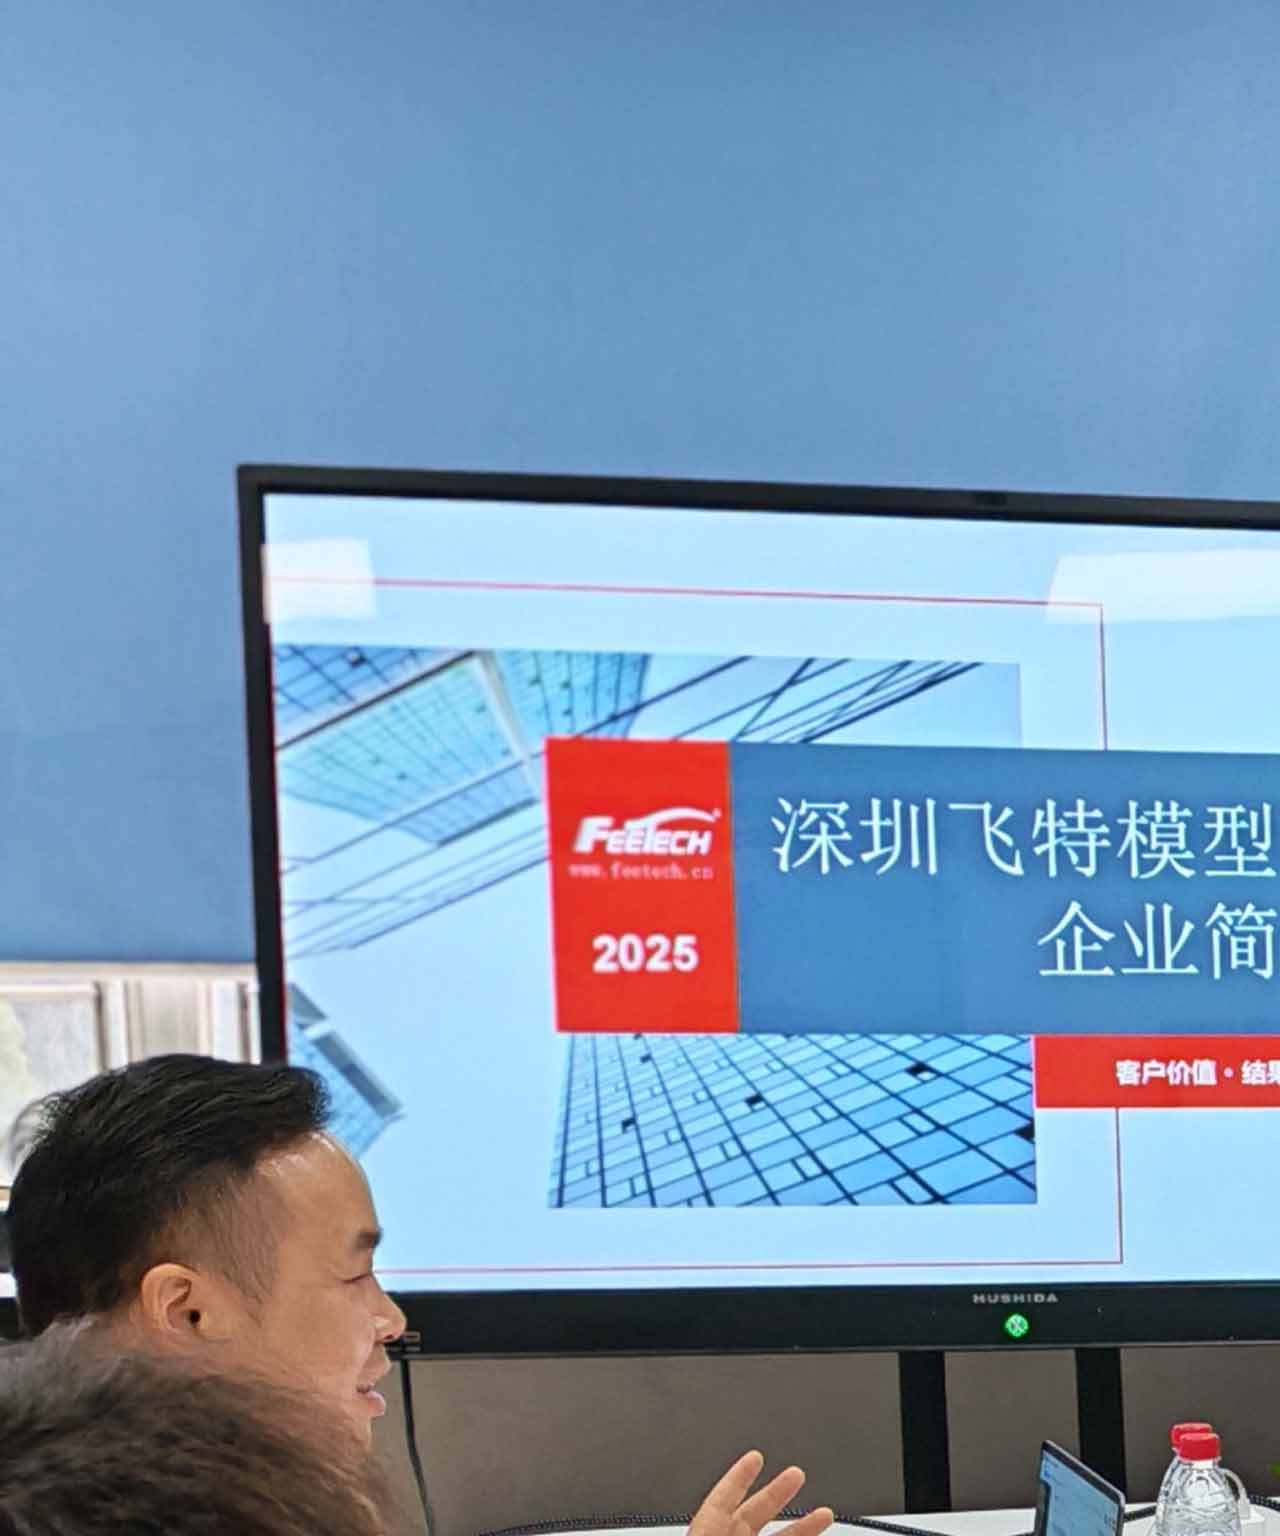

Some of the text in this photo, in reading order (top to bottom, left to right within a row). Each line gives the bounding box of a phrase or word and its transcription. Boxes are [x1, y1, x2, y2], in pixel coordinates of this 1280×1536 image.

[568, 861, 714, 880] www.feetech.cn
[592, 931, 699, 973] 2025
[972, 1292, 1059, 1304] HUSHIDA
